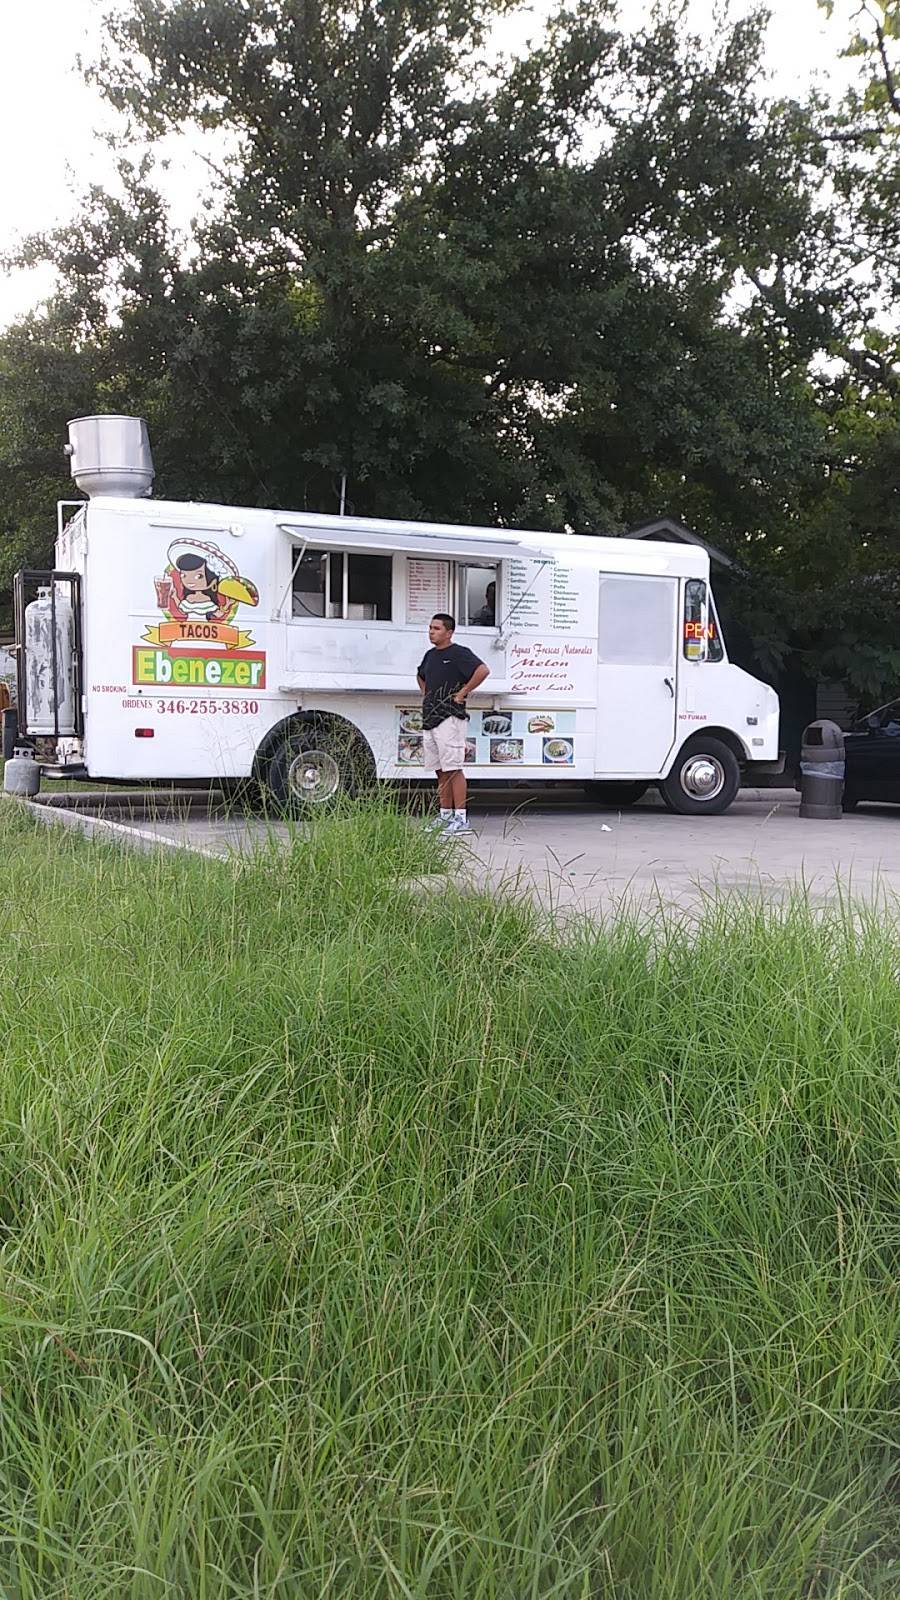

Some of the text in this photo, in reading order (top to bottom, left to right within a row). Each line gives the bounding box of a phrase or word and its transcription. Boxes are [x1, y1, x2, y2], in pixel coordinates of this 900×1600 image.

[179, 624, 218, 639] TACOS
[685, 623, 714, 638] PEN
[511, 643, 593, 657] Aguas Frescas Naturales
[137, 650, 263, 685] Ebenezer
[510, 658, 569, 669] Melon
[510, 670, 568, 680] Jamaica
[92, 685, 127, 693] NO SMOKING
[511, 683, 541, 691] Kool
[122, 699, 259, 715] ORDENES 346-255-3830
